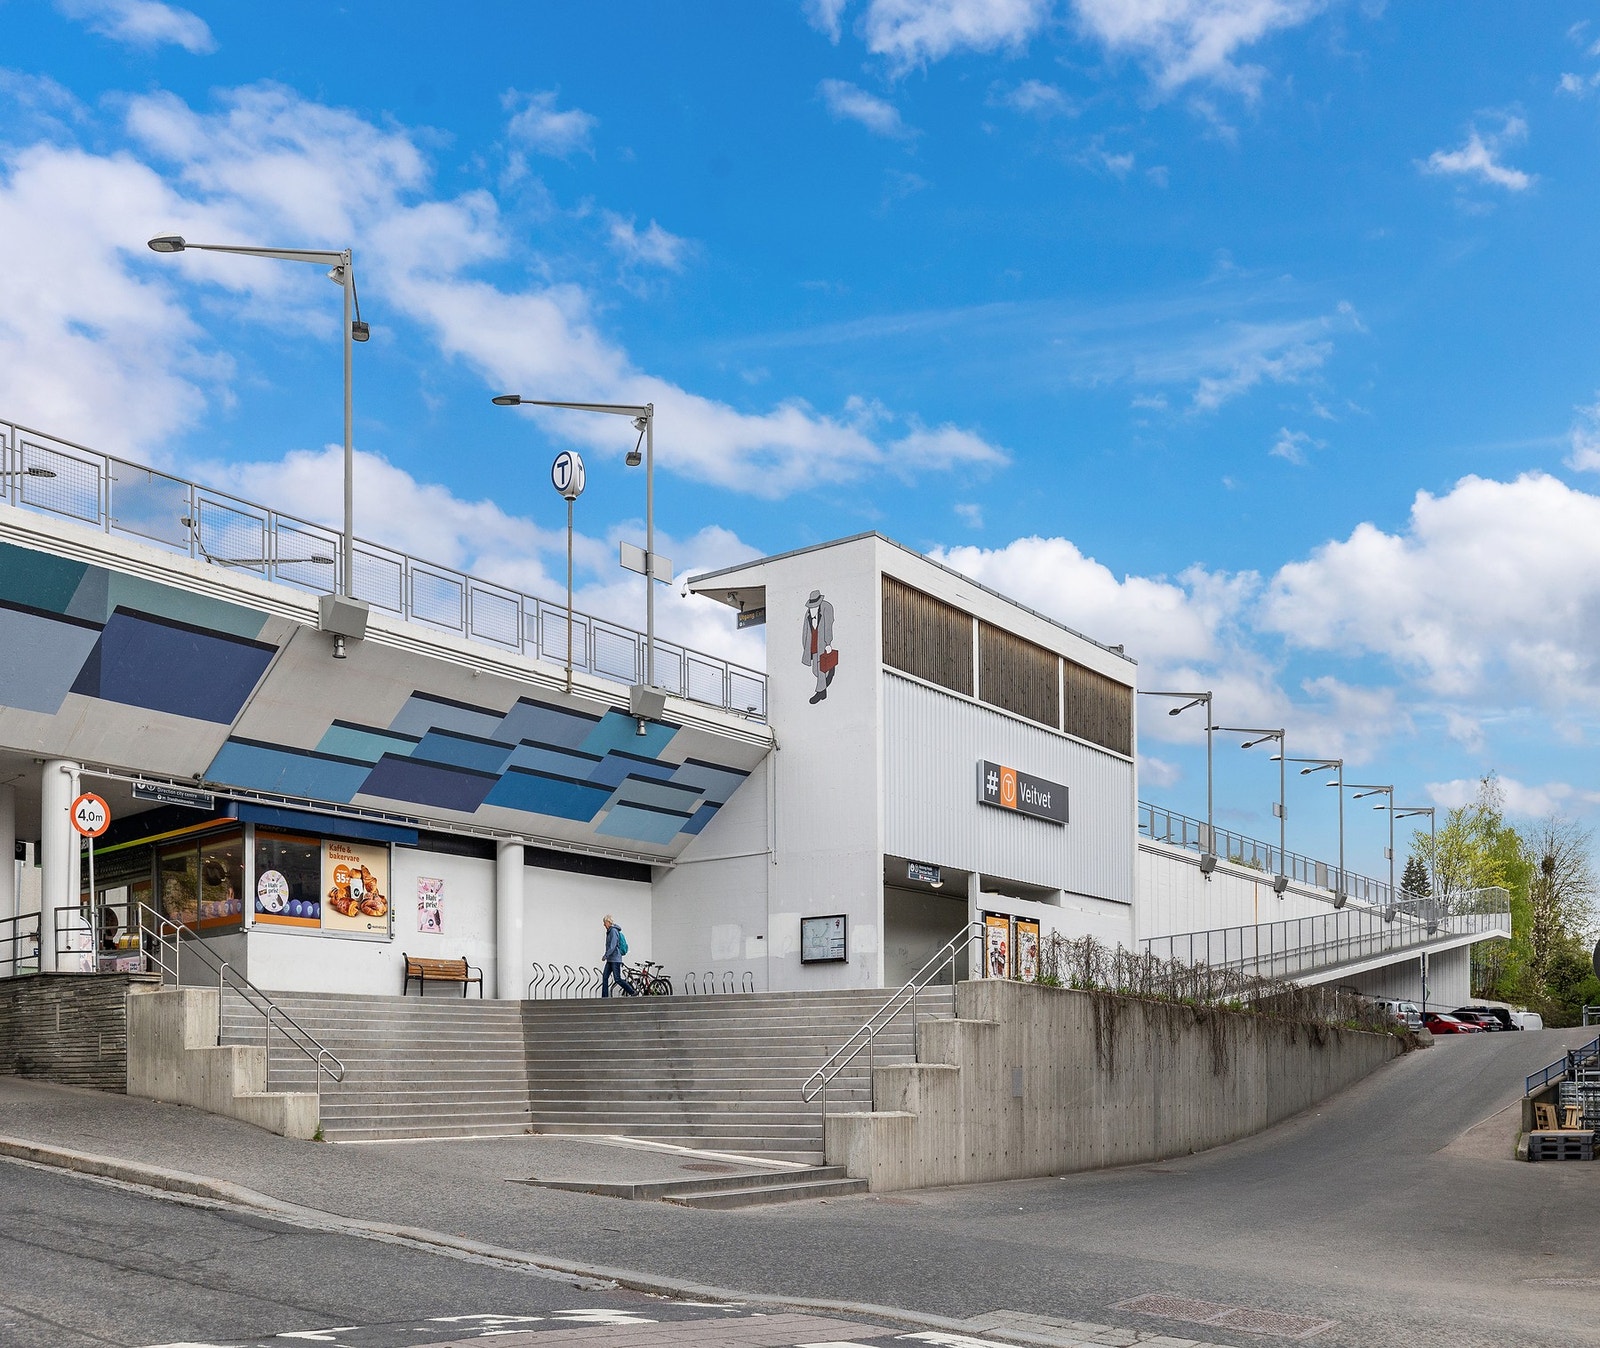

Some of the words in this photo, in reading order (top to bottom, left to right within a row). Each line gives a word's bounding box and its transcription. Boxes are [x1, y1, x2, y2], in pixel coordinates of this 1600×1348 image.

[557, 460, 569, 485] T
[1019, 781, 1052, 809] Veitvet
[328, 843, 346, 854] Kaffe
[346, 846, 352, 854] &
[329, 851, 360, 863] bakervare
